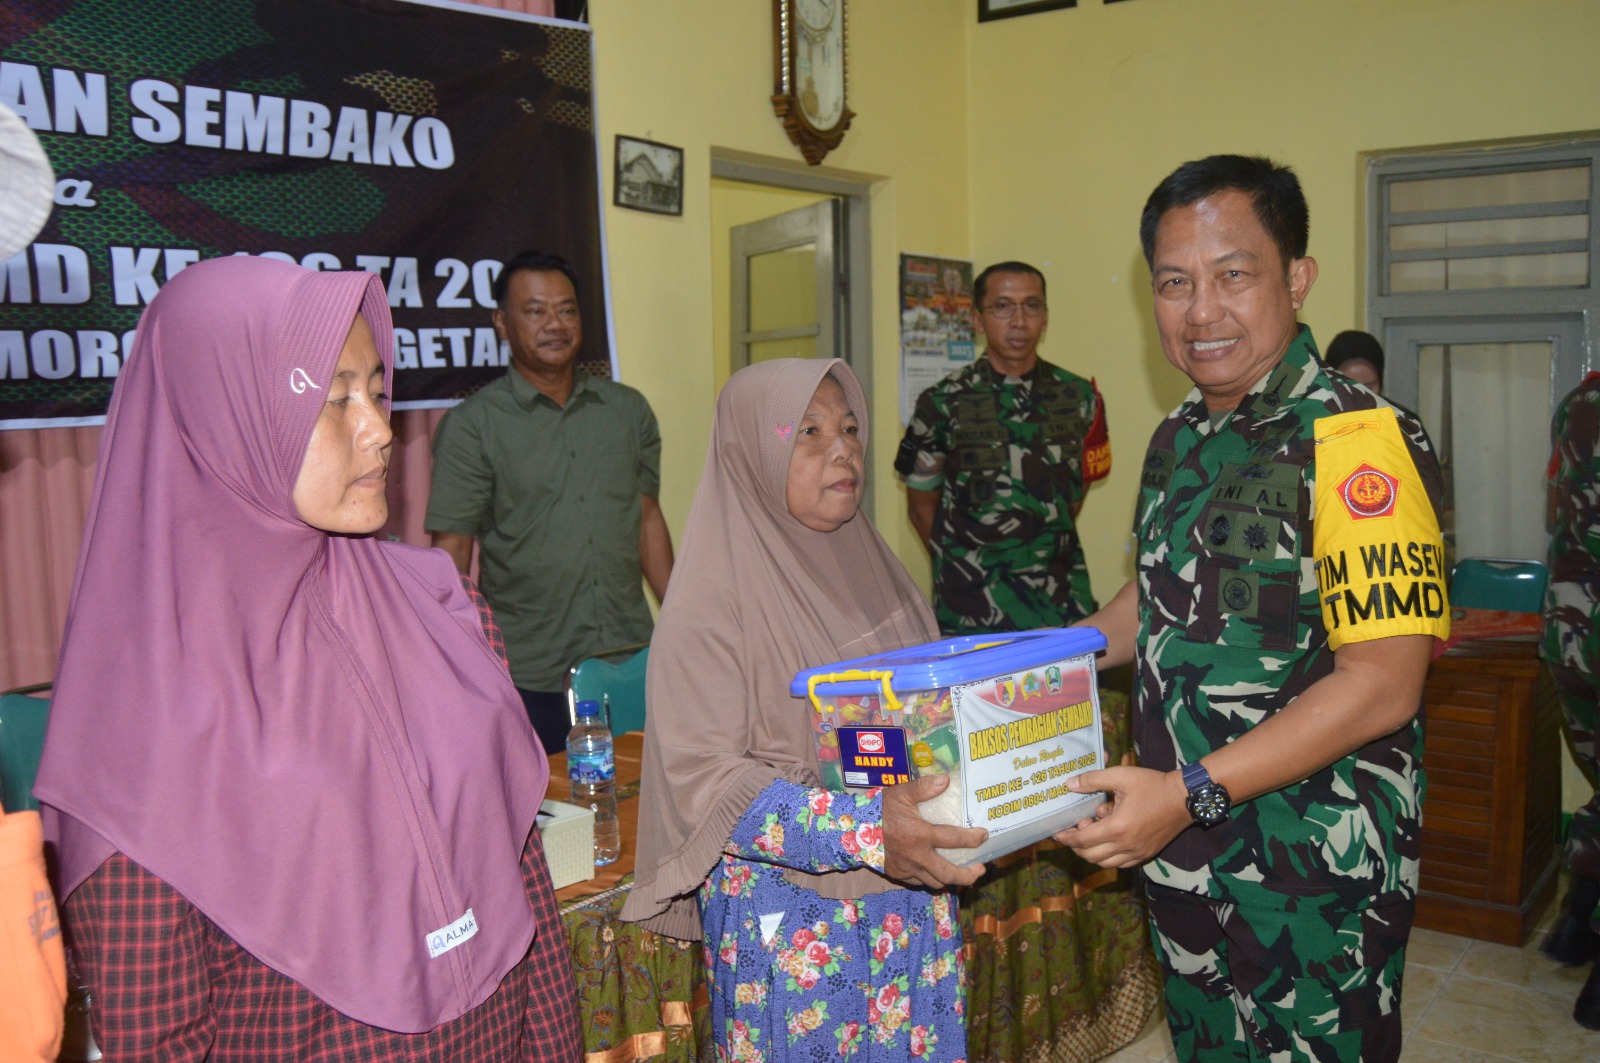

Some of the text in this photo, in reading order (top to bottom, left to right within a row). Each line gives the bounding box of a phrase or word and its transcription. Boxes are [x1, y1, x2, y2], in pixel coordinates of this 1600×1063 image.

[129, 78, 455, 170] SEMBAKO
[1256, 489, 1287, 507] AL
[1314, 550, 1349, 594] TIM
[1324, 582, 1445, 629] TMMD
[860, 739, 882, 747] SHINPO
[969, 700, 1093, 761] BAKSOS PEMBAGIAN SEMBAKO
[854, 755, 894, 768] HANDY
[881, 773, 895, 785] CB
[897, 774, 909, 784] 15
[975, 783, 1007, 803] TMMD
[1008, 778, 1023, 792] KE
[1030, 771, 1047, 785] 126
[1047, 761, 1077, 780] TAHUN
[1077, 752, 1096, 769] 2025
[988, 800, 1022, 821] KODIM
[1023, 792, 1045, 809] 0804
[1049, 782, 1070, 800] MAG
